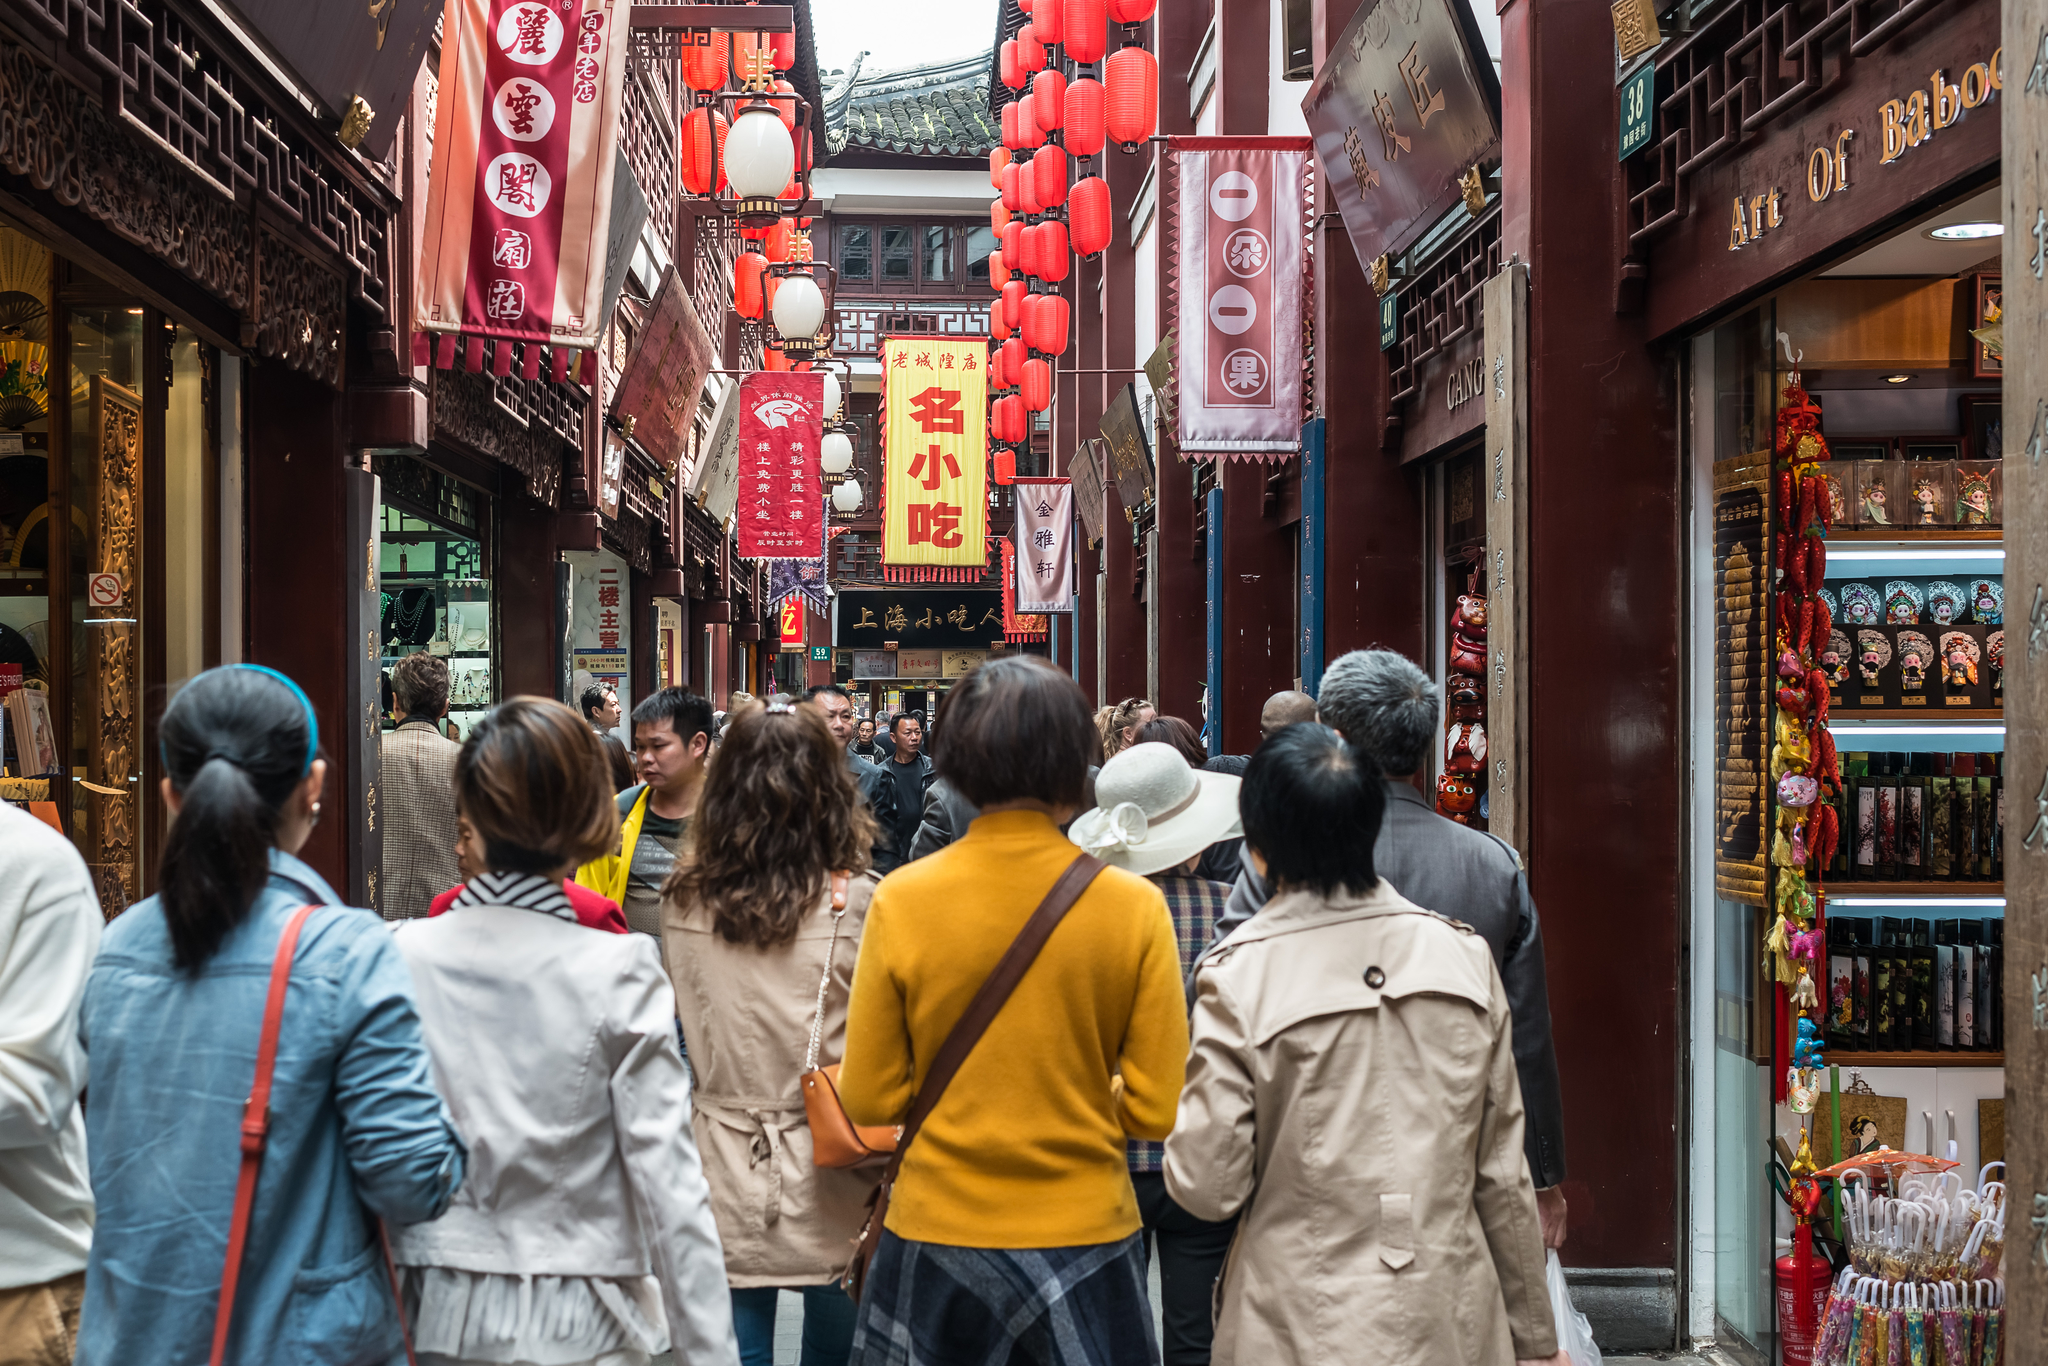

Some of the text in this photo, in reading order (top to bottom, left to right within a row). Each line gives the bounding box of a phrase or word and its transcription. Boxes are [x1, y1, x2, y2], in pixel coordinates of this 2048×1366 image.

[573, 10, 604, 103] 百年老店
[1627, 78, 1644, 126] 38
[1728, 187, 1783, 251] Art
[1808, 129, 1853, 202] Of
[1383, 300, 1392, 329] 40
[892, 351, 977, 371] 老城隍庙
[1447, 356, 1484, 411] CANG
[755, 442, 771, 520] 楼上免费小坐
[789, 441, 804, 520] 精彩更胜一楼
[907, 387, 964, 549] 名小吃
[1034, 499, 1055, 579] 金雅轩
[815, 648, 826, 656] 59
